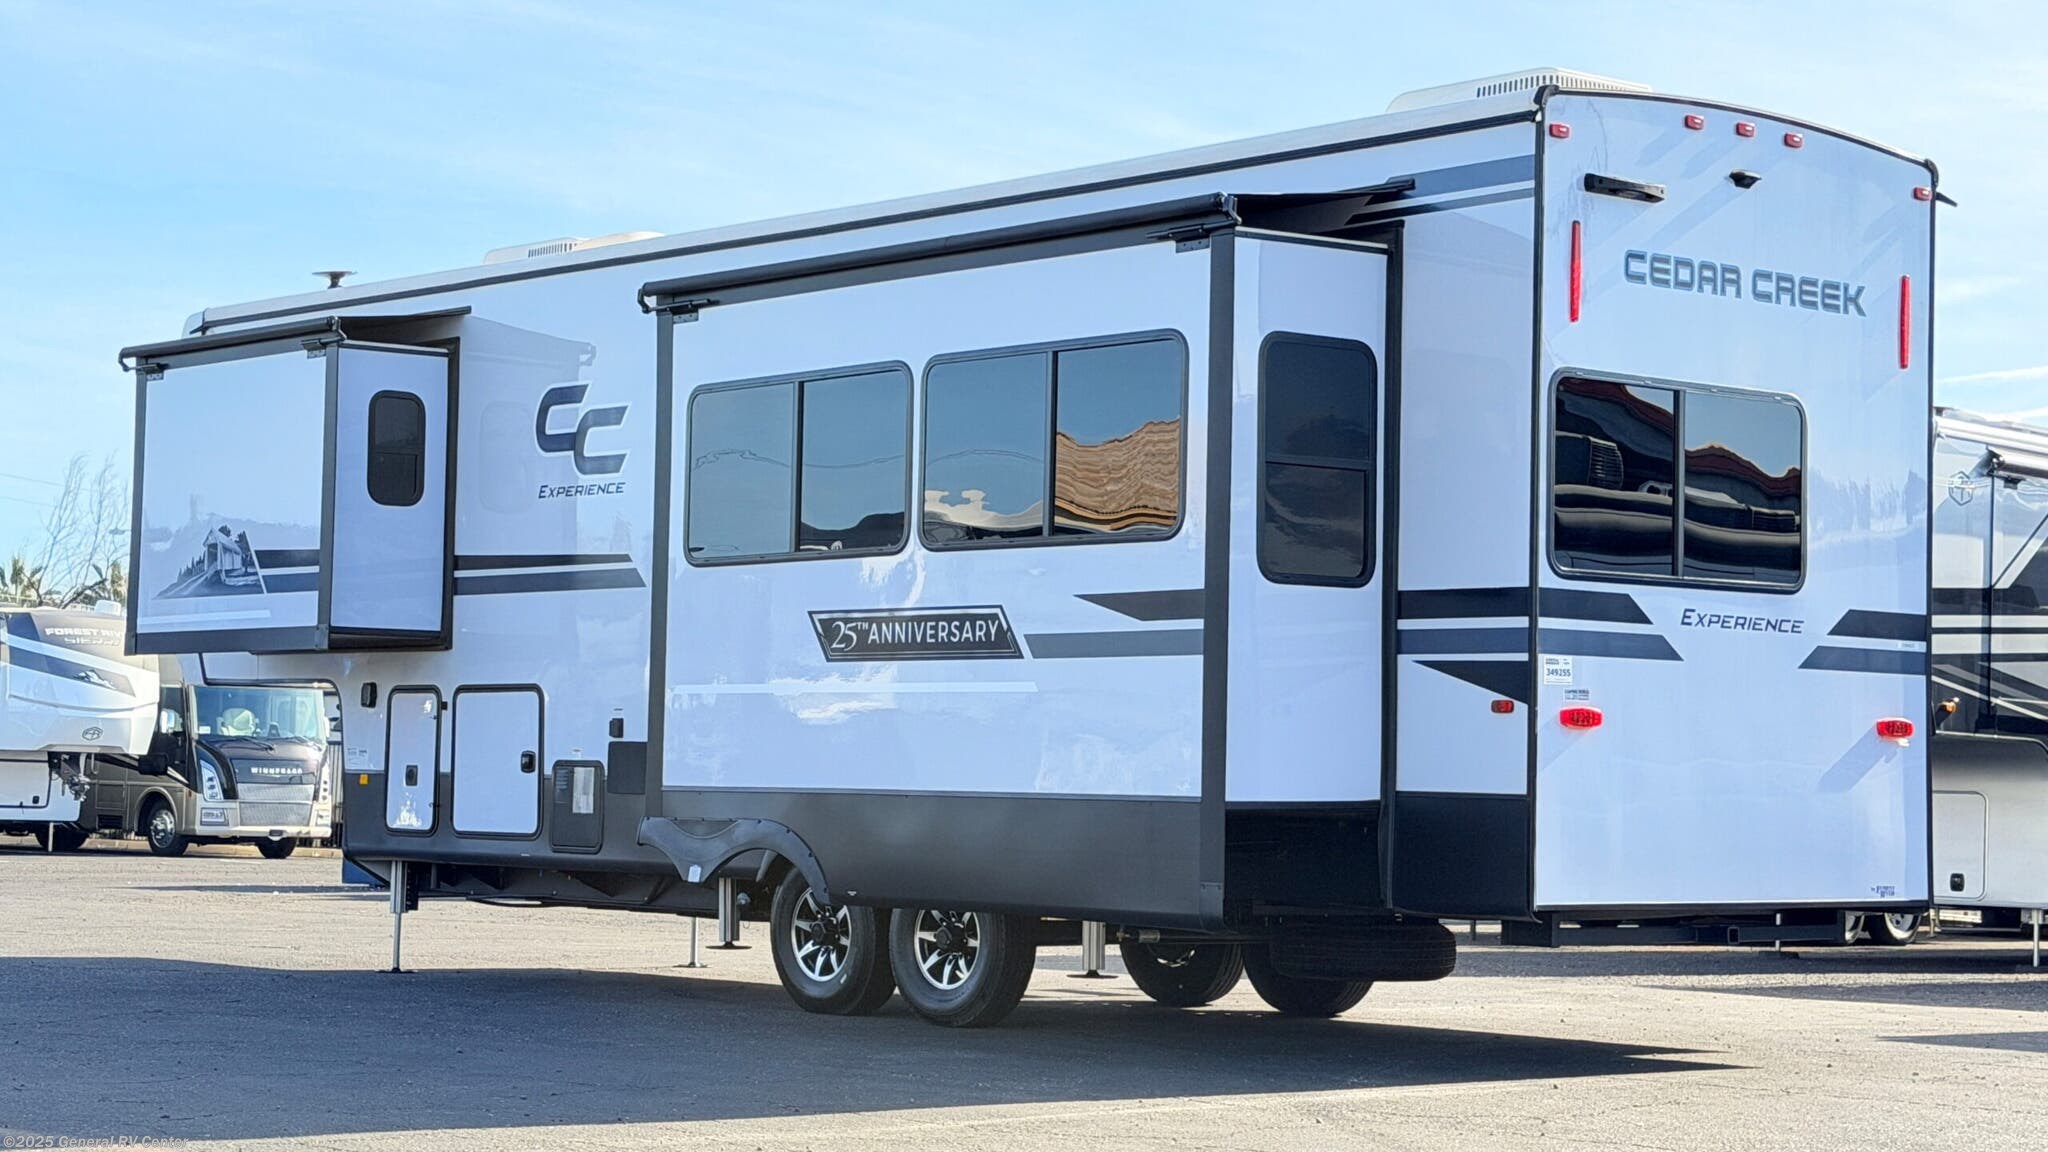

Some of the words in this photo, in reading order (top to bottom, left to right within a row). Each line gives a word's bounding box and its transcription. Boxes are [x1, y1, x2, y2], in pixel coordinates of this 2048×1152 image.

[1624, 249, 1743, 299] CEDAR
[1751, 268, 1867, 317] CREEK
[44, 627, 98, 637] FOREST
[868, 619, 1000, 645] ANNIVERSARY
